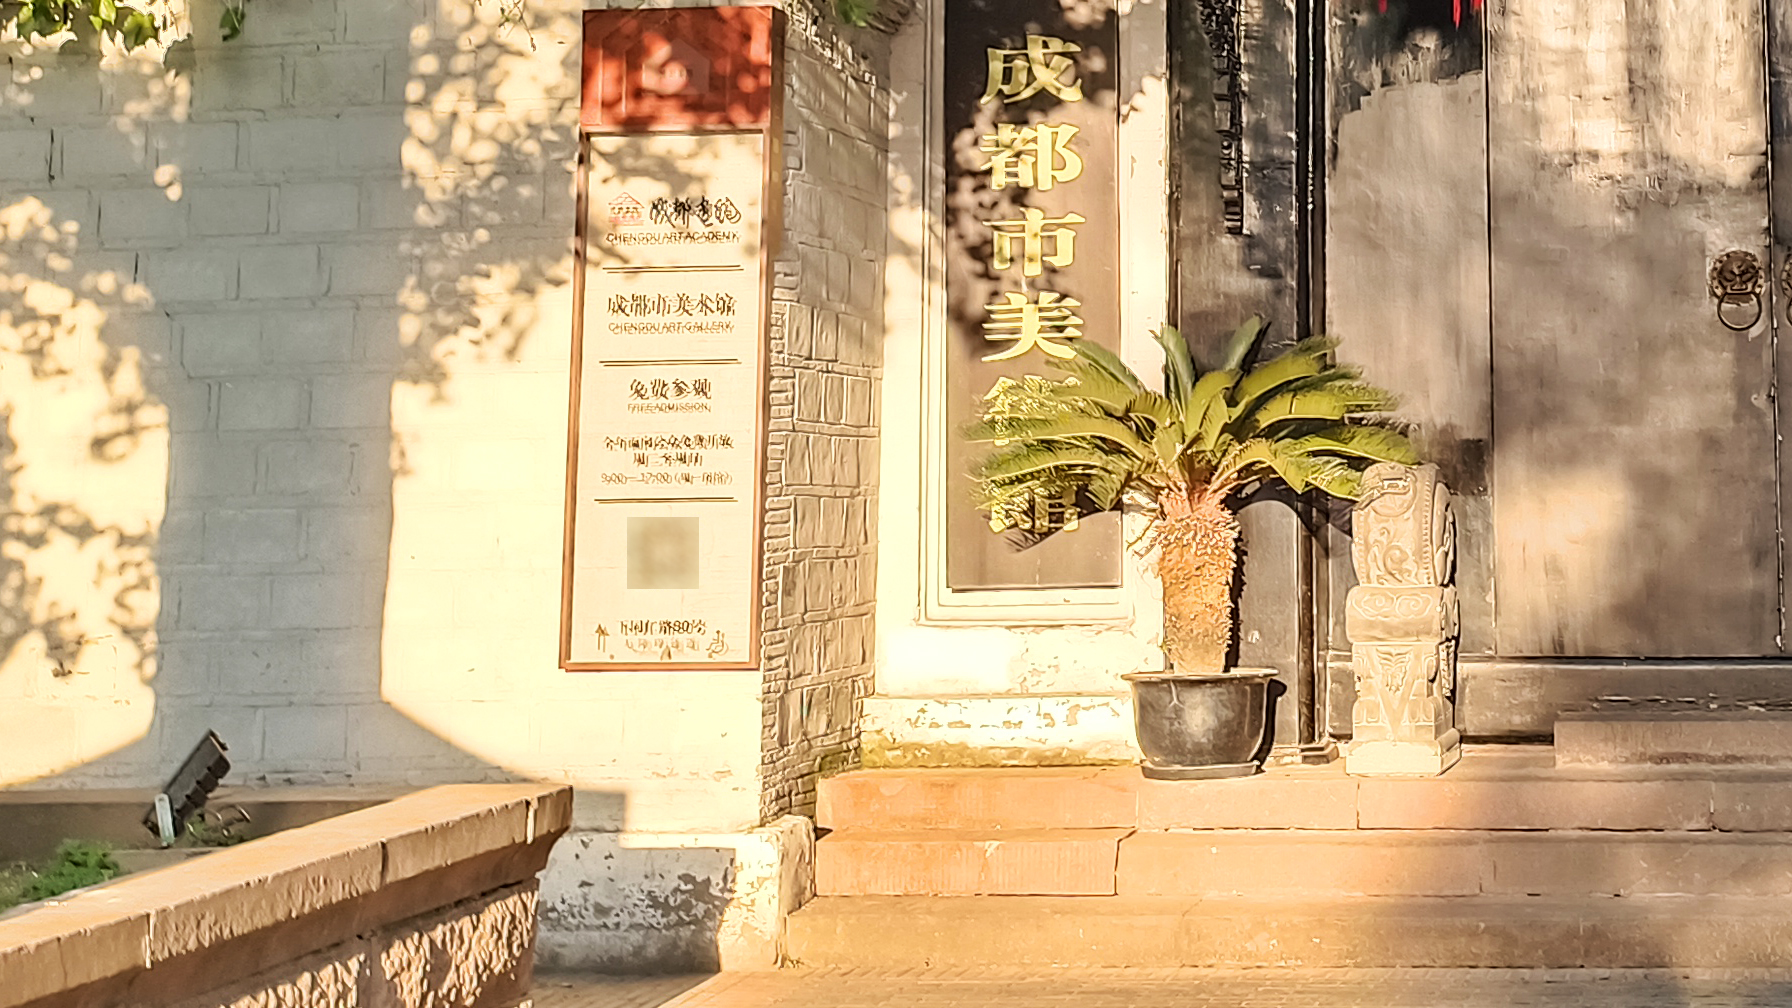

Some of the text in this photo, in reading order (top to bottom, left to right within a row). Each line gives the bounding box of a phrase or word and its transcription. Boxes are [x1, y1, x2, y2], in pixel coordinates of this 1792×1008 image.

[606, 231, 741, 245] CHENGDU ART ACADEMY
[980, 32, 1085, 533] 成都市美
[607, 293, 736, 316] 成都市美术馆
[608, 321, 734, 334] CHENGDU ART GALLERY
[628, 378, 711, 400] 免费参观
[654, 402, 711, 413] ADMISSION
